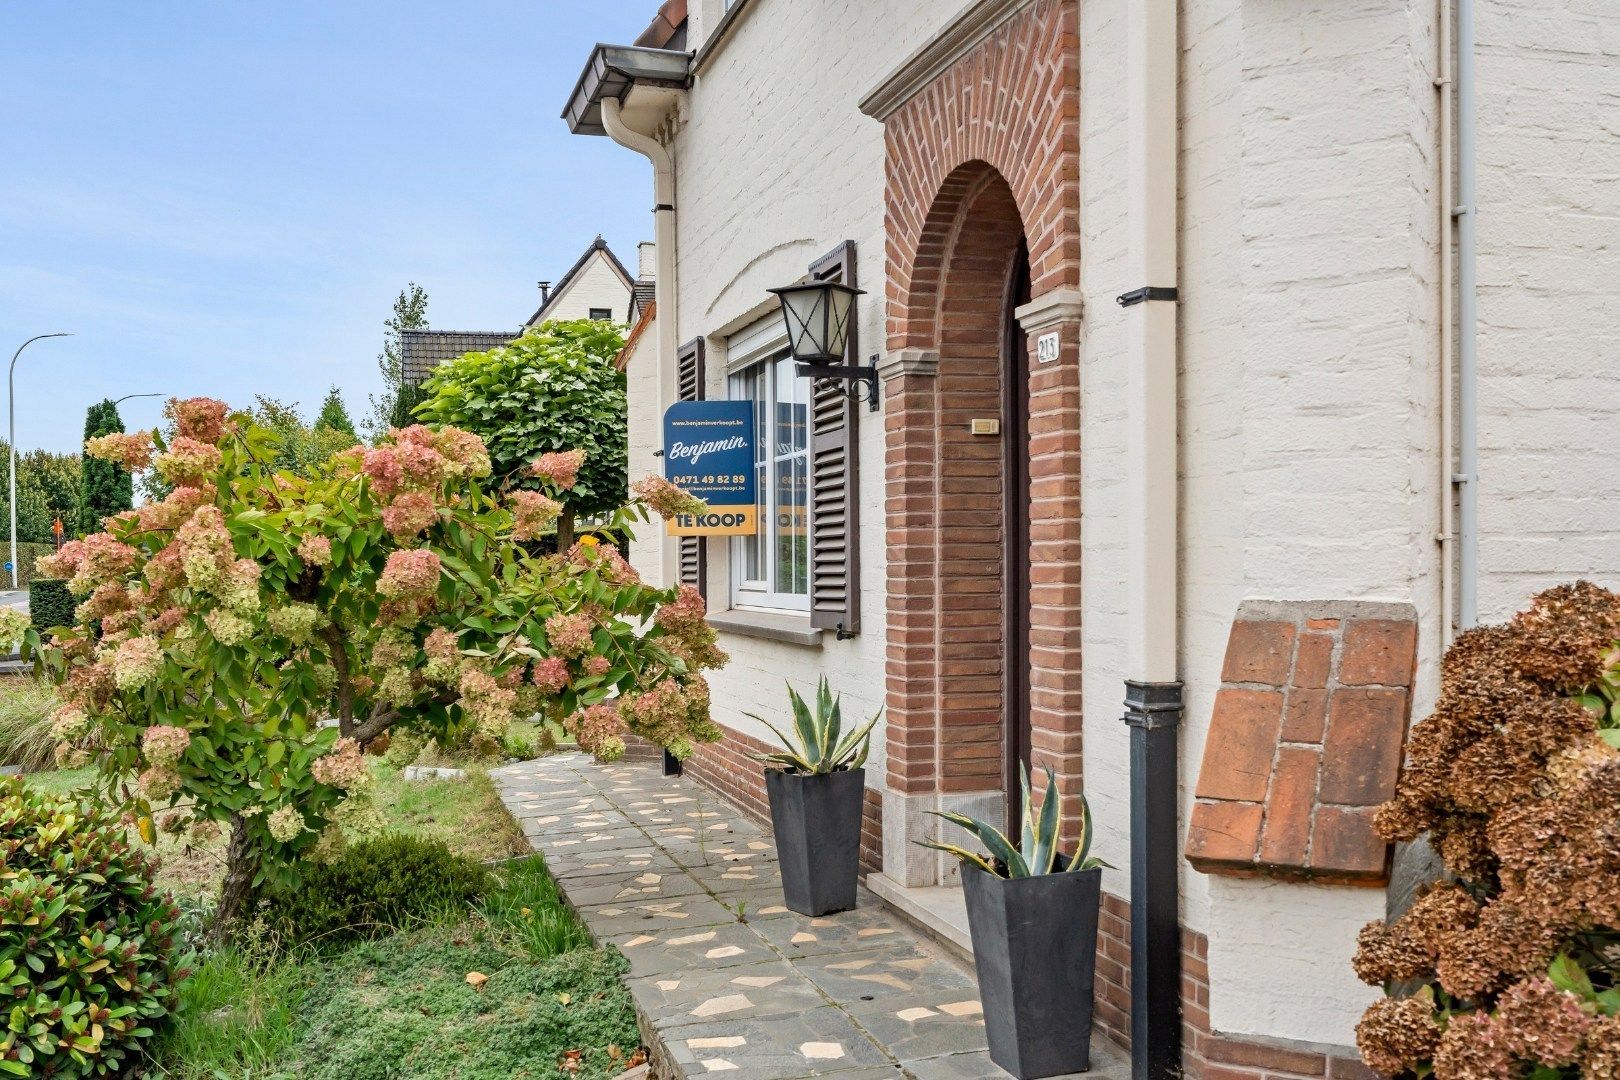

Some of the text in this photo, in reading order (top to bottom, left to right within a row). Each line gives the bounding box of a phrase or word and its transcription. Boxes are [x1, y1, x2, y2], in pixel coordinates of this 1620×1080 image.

[1039, 338, 1056, 361] 213
[673, 475, 746, 484] 0471 49 82 89
[675, 513, 693, 527] TE
[696, 513, 746, 527] KOOP
